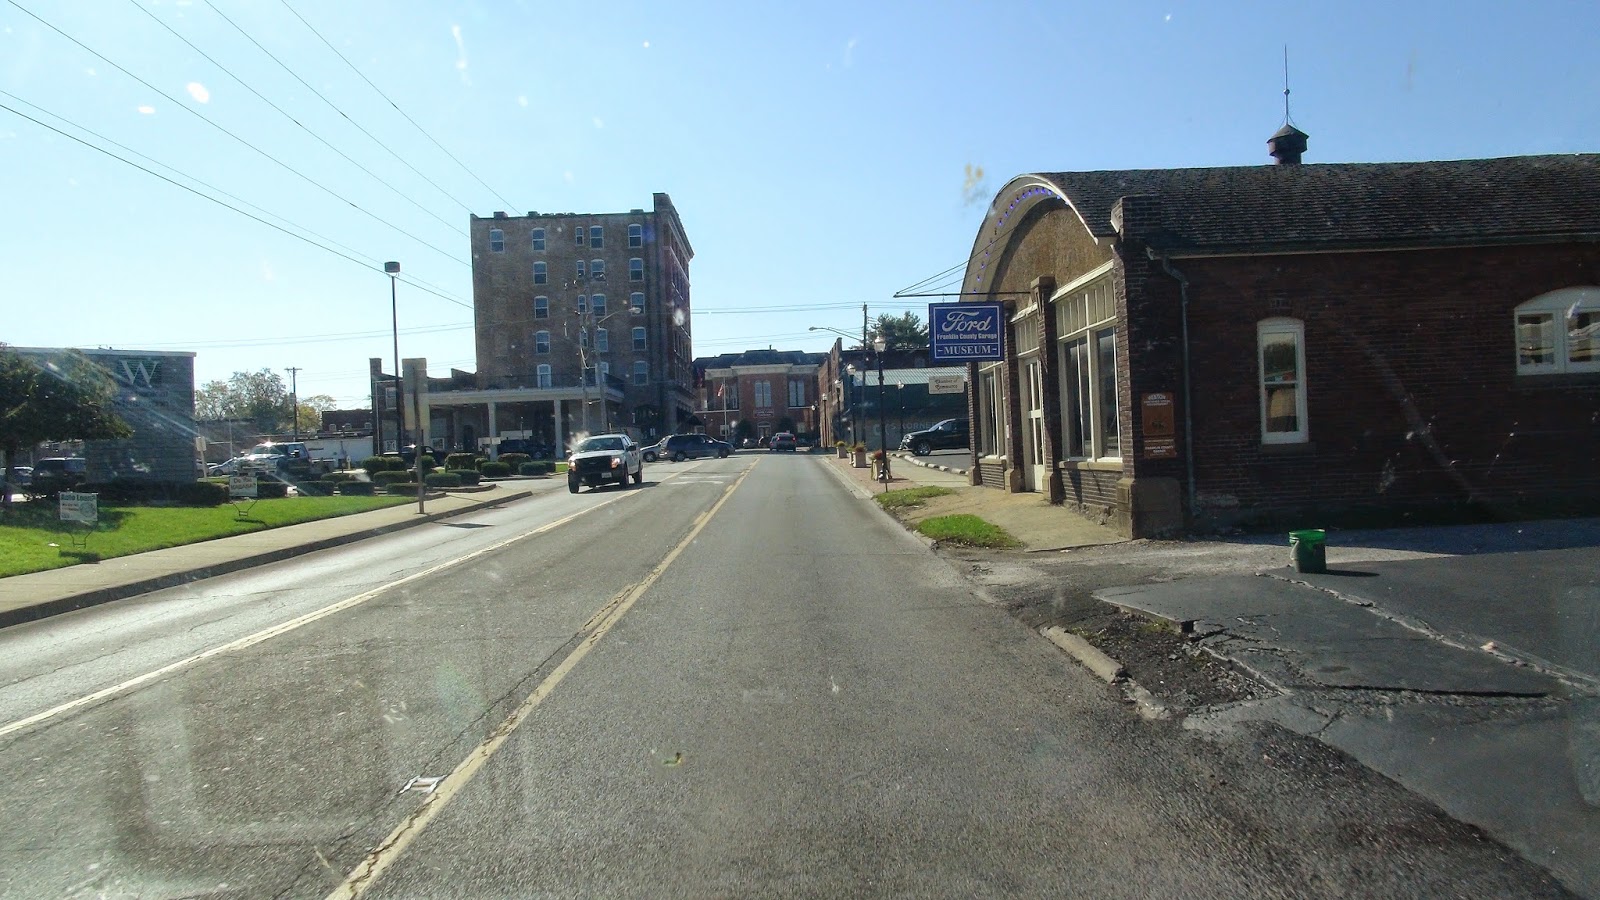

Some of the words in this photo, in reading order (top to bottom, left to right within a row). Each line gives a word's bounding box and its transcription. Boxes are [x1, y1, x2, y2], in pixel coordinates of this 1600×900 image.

[941, 311, 992, 332] Ford
[943, 345, 991, 355] MUSEUM
[120, 359, 160, 388] W
